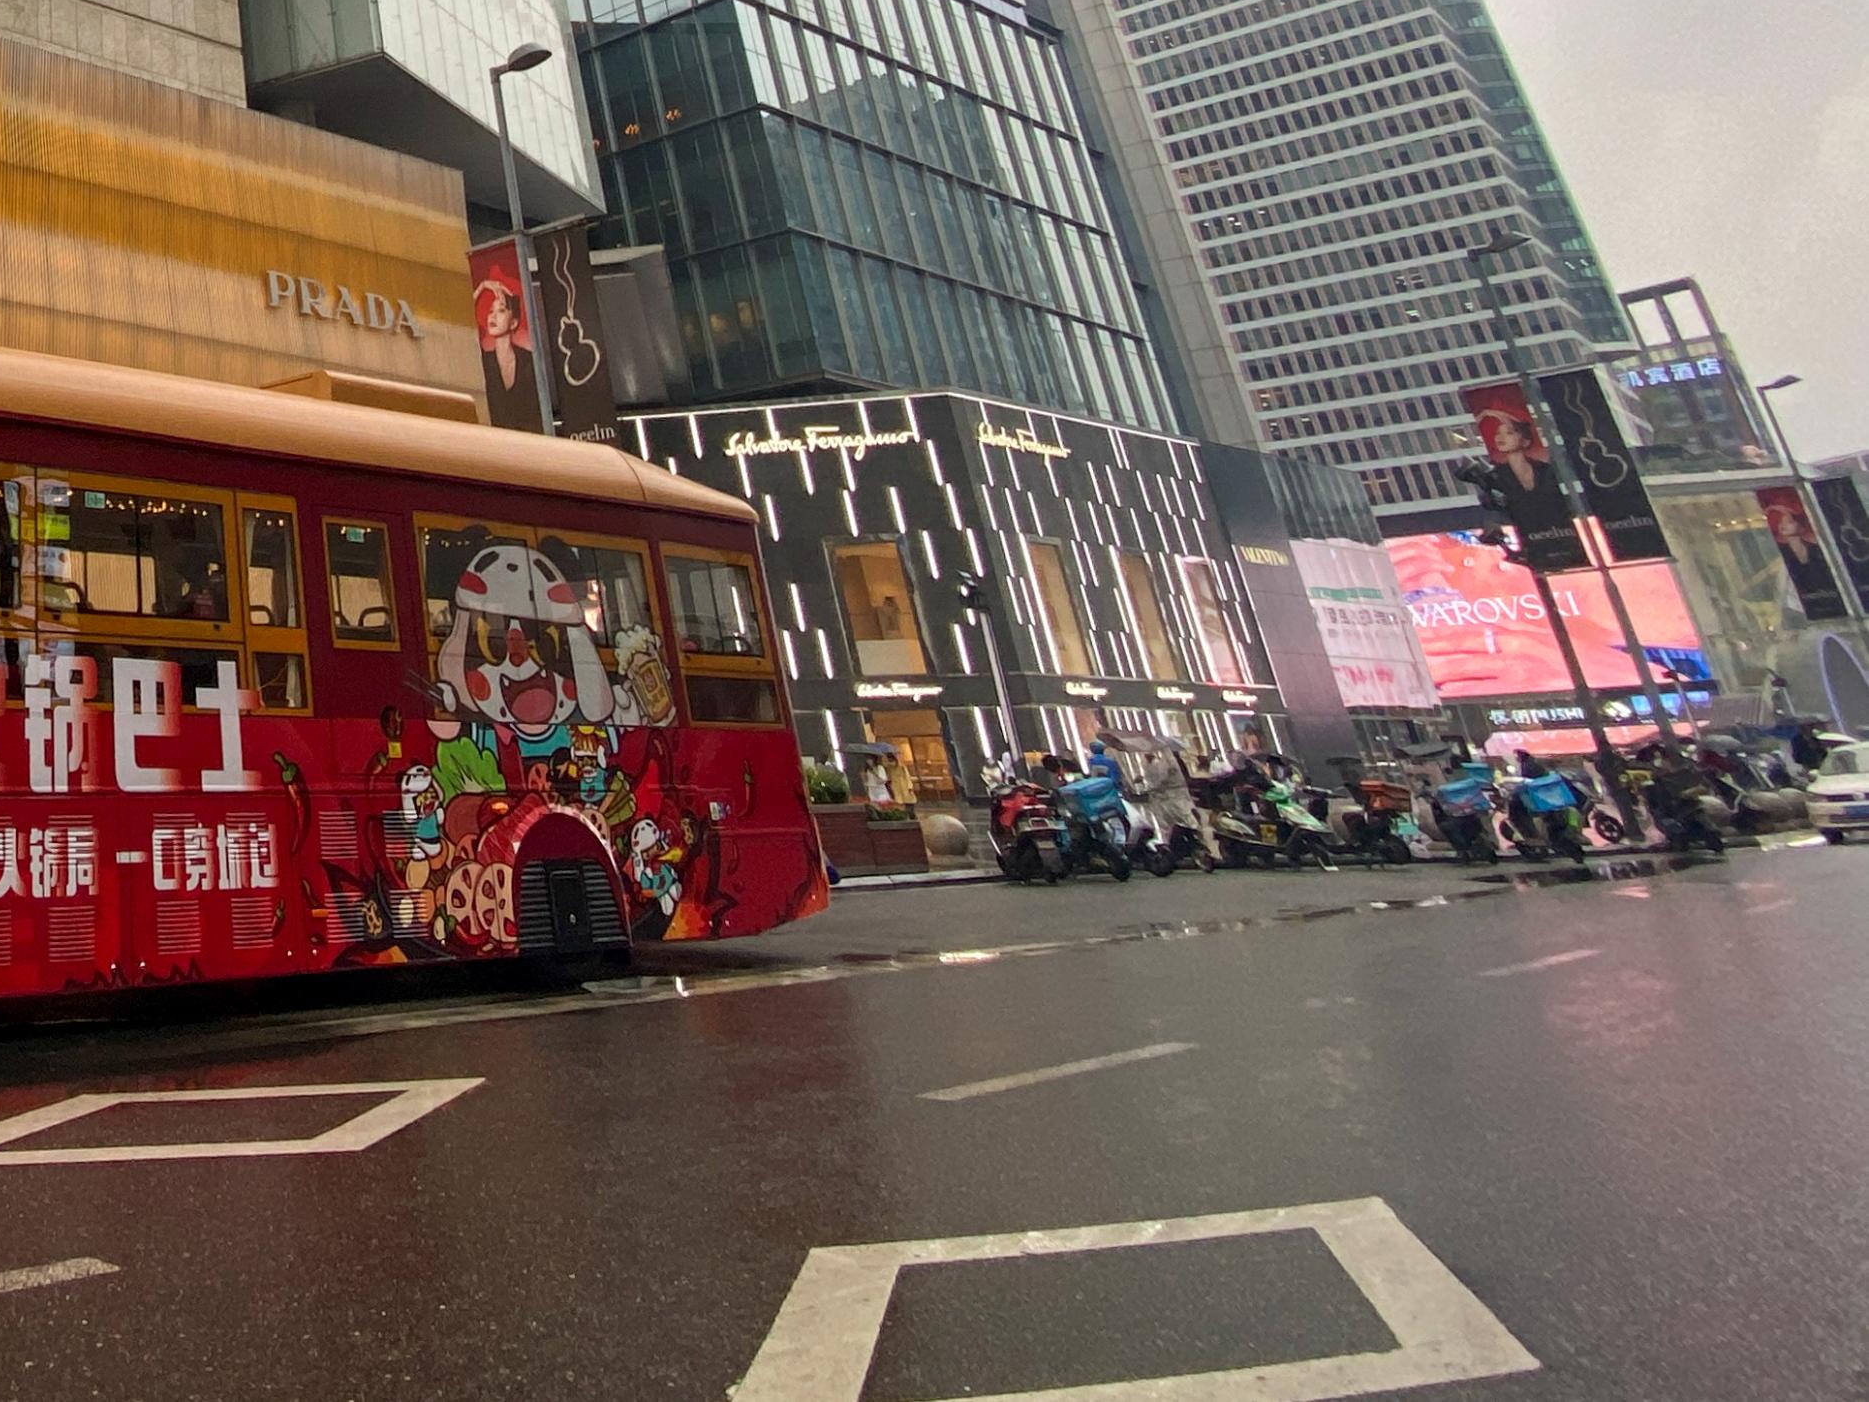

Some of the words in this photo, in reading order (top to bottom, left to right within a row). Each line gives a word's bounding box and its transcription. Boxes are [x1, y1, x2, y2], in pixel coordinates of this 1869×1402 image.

[266, 269, 426, 338] PRADA
[724, 430, 807, 457] Salvatore
[803, 425, 921, 461] Ferragamo
